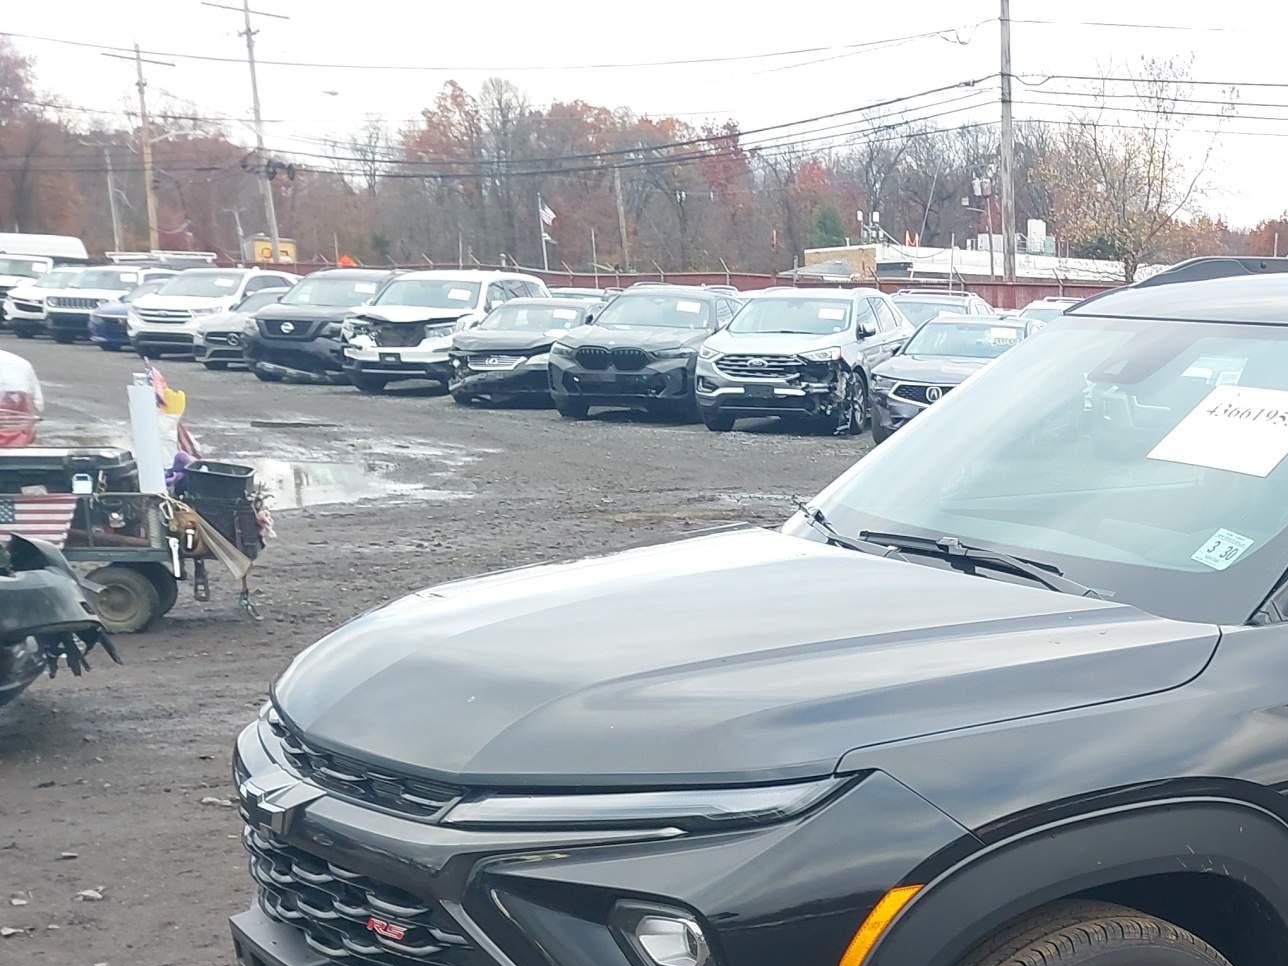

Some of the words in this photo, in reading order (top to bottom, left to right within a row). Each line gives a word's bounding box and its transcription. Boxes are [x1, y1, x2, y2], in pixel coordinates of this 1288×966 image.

[1206, 540, 1222, 553] 3
[1219, 546, 1239, 561] 30
[367, 917, 408, 940] RS
